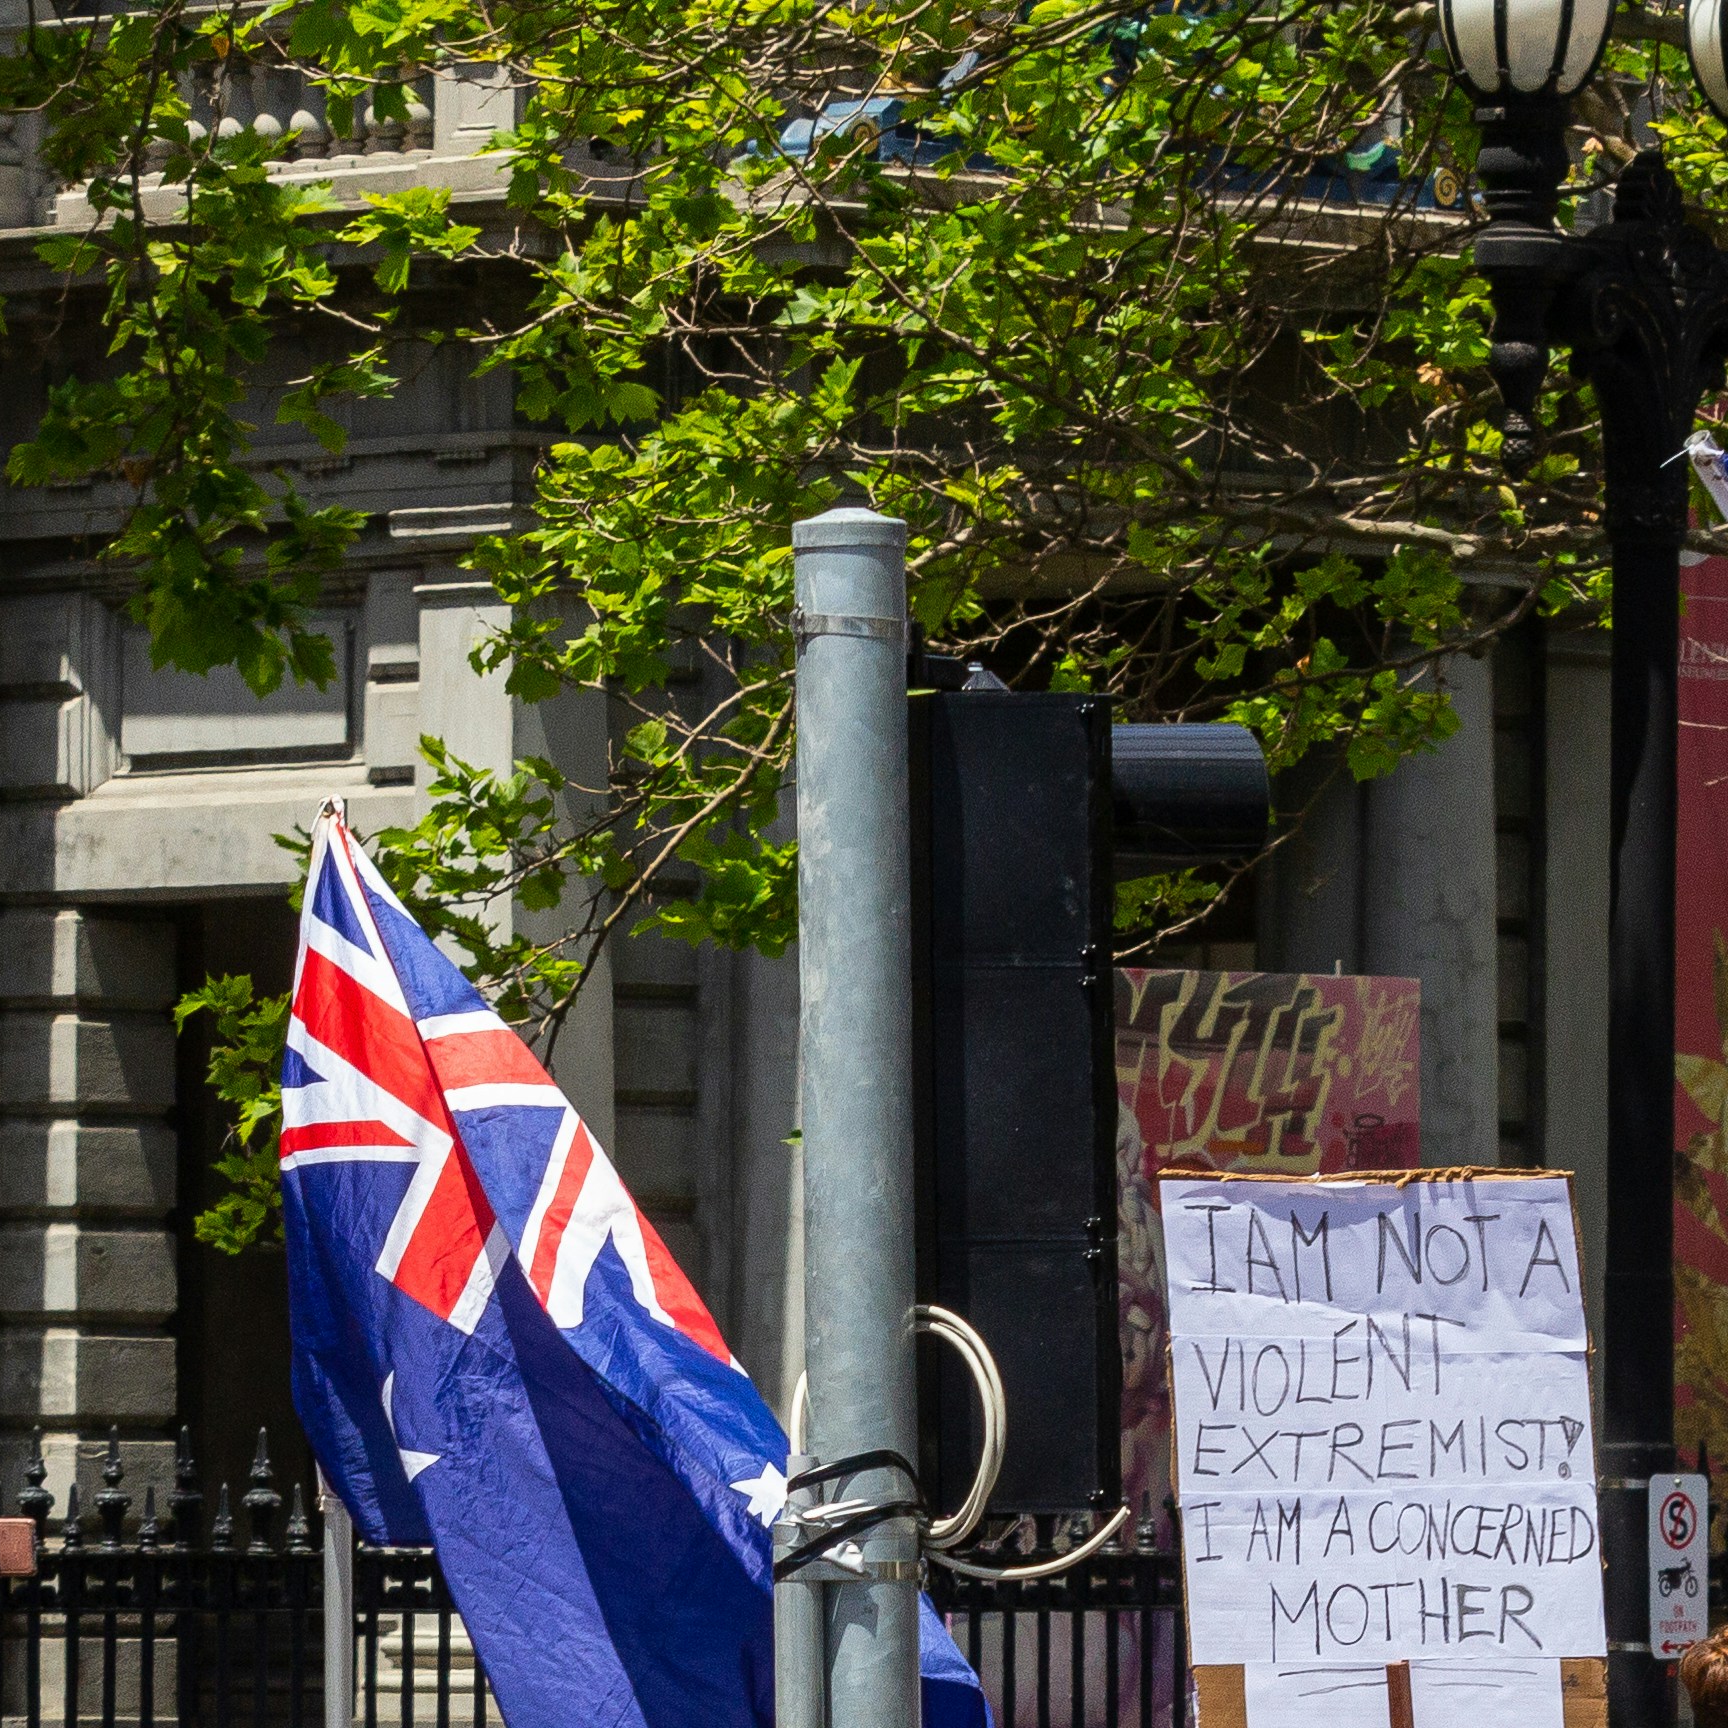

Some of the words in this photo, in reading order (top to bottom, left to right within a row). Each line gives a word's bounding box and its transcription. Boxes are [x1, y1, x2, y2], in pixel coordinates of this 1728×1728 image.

[1184, 1204, 1236, 1294] I
[1246, 1207, 1334, 1304] AM
[1376, 1211, 1502, 1295] NOT
[1519, 1217, 1571, 1298] A
[1191, 1312, 1467, 1417] VIOLENT
[1193, 1415, 1586, 1484] EXTREMIST!
[1190, 1501, 1224, 1563] I
[1246, 1497, 1302, 1565] AM
[1323, 1495, 1355, 1557] A
[1368, 1498, 1596, 1567] CONCERNED
[1269, 1576, 1544, 1664] MOTHER
